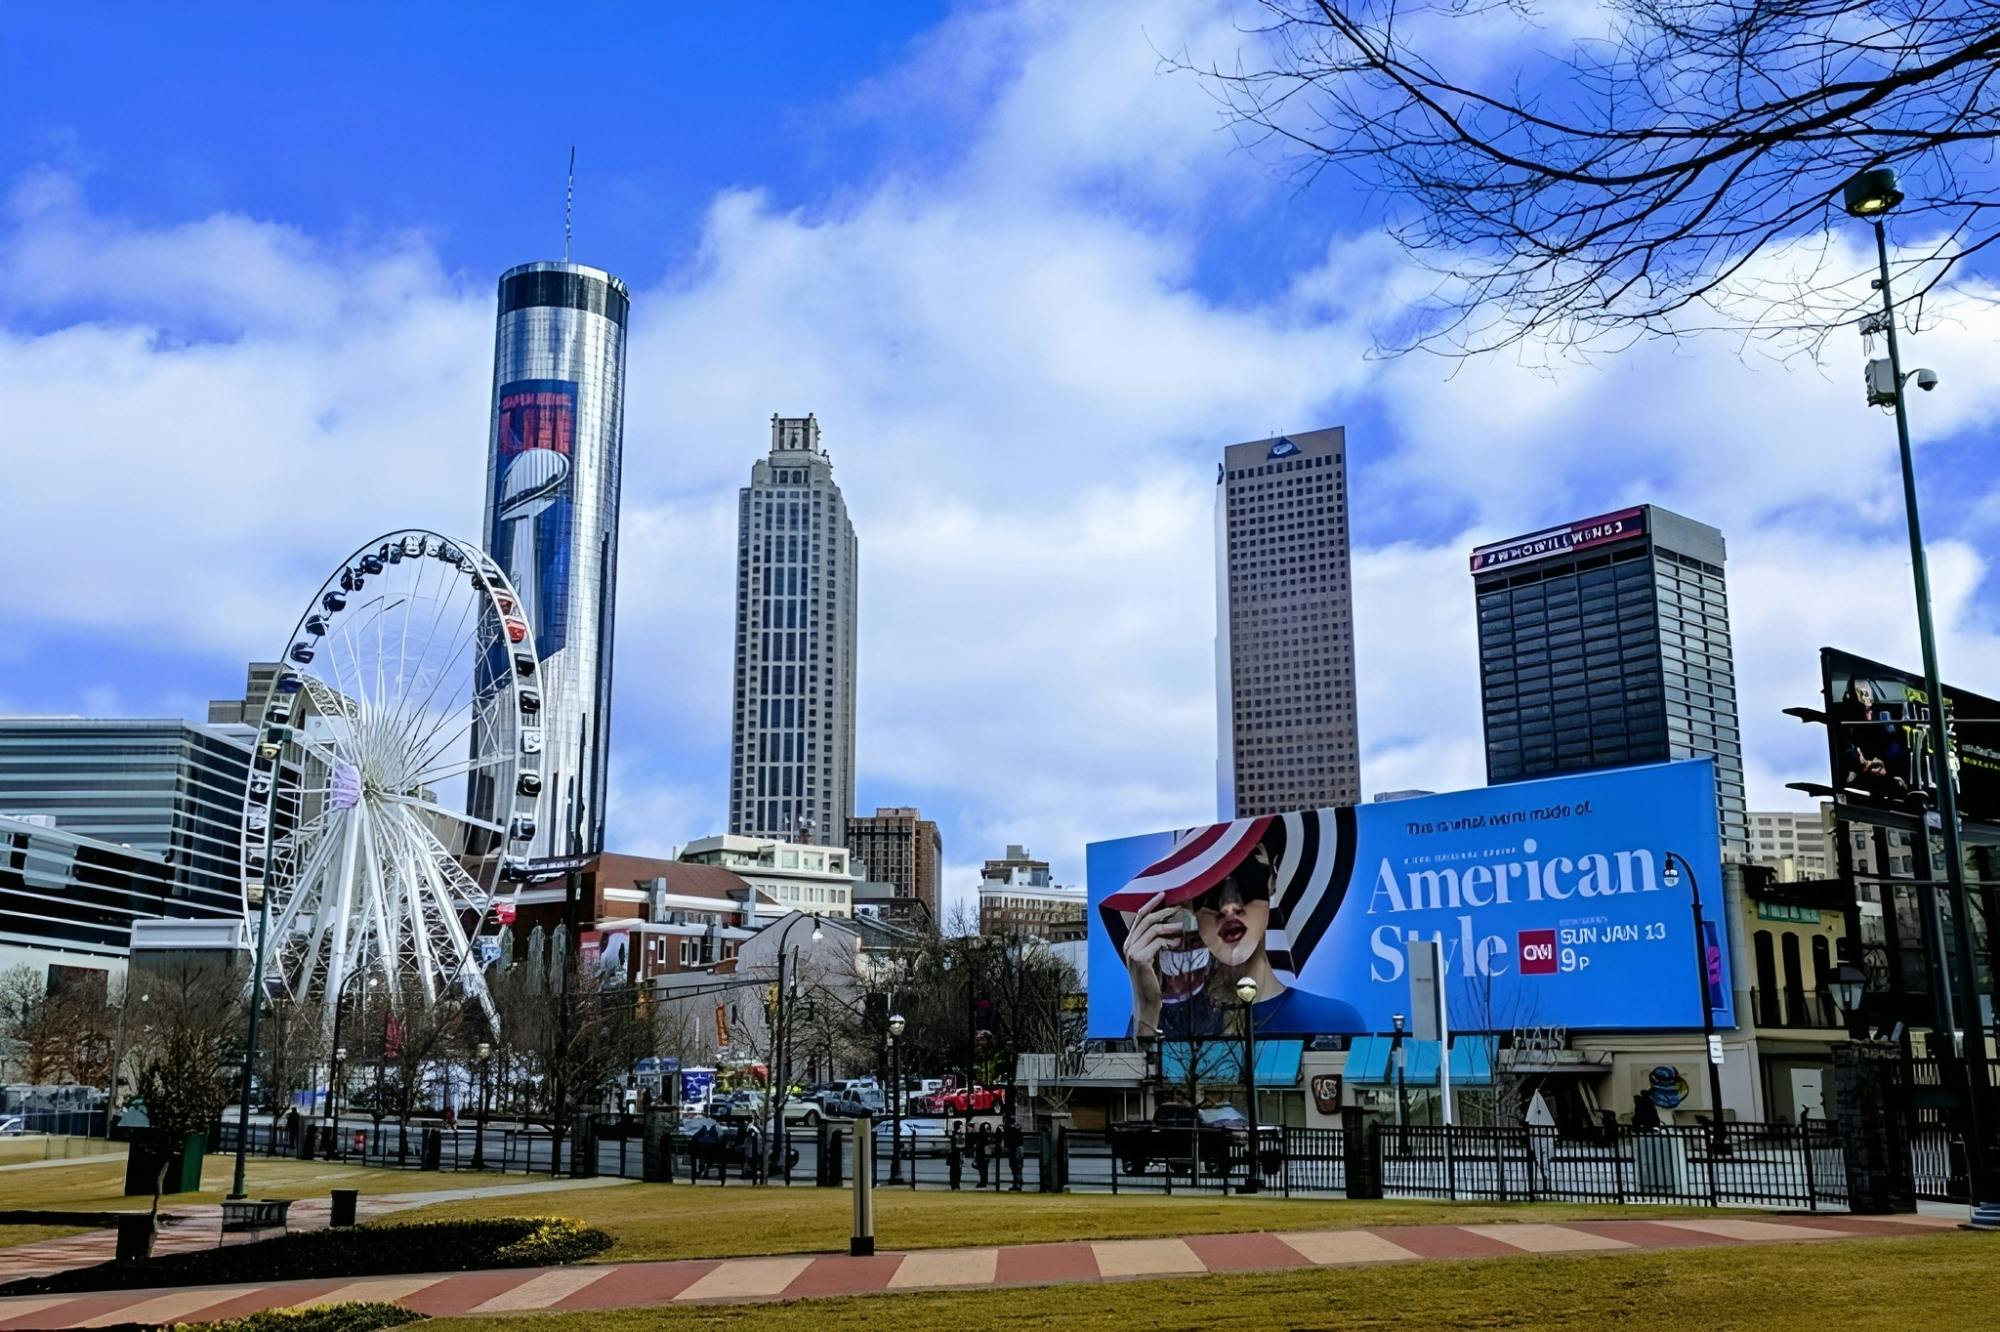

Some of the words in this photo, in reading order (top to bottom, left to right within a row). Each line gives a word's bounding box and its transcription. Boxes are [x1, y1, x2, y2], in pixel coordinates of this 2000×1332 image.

[1367, 838, 1659, 914] American
[1560, 927, 1597, 945] SUN
[1602, 924, 1638, 943] JAN
[1645, 922, 1666, 941] 13
